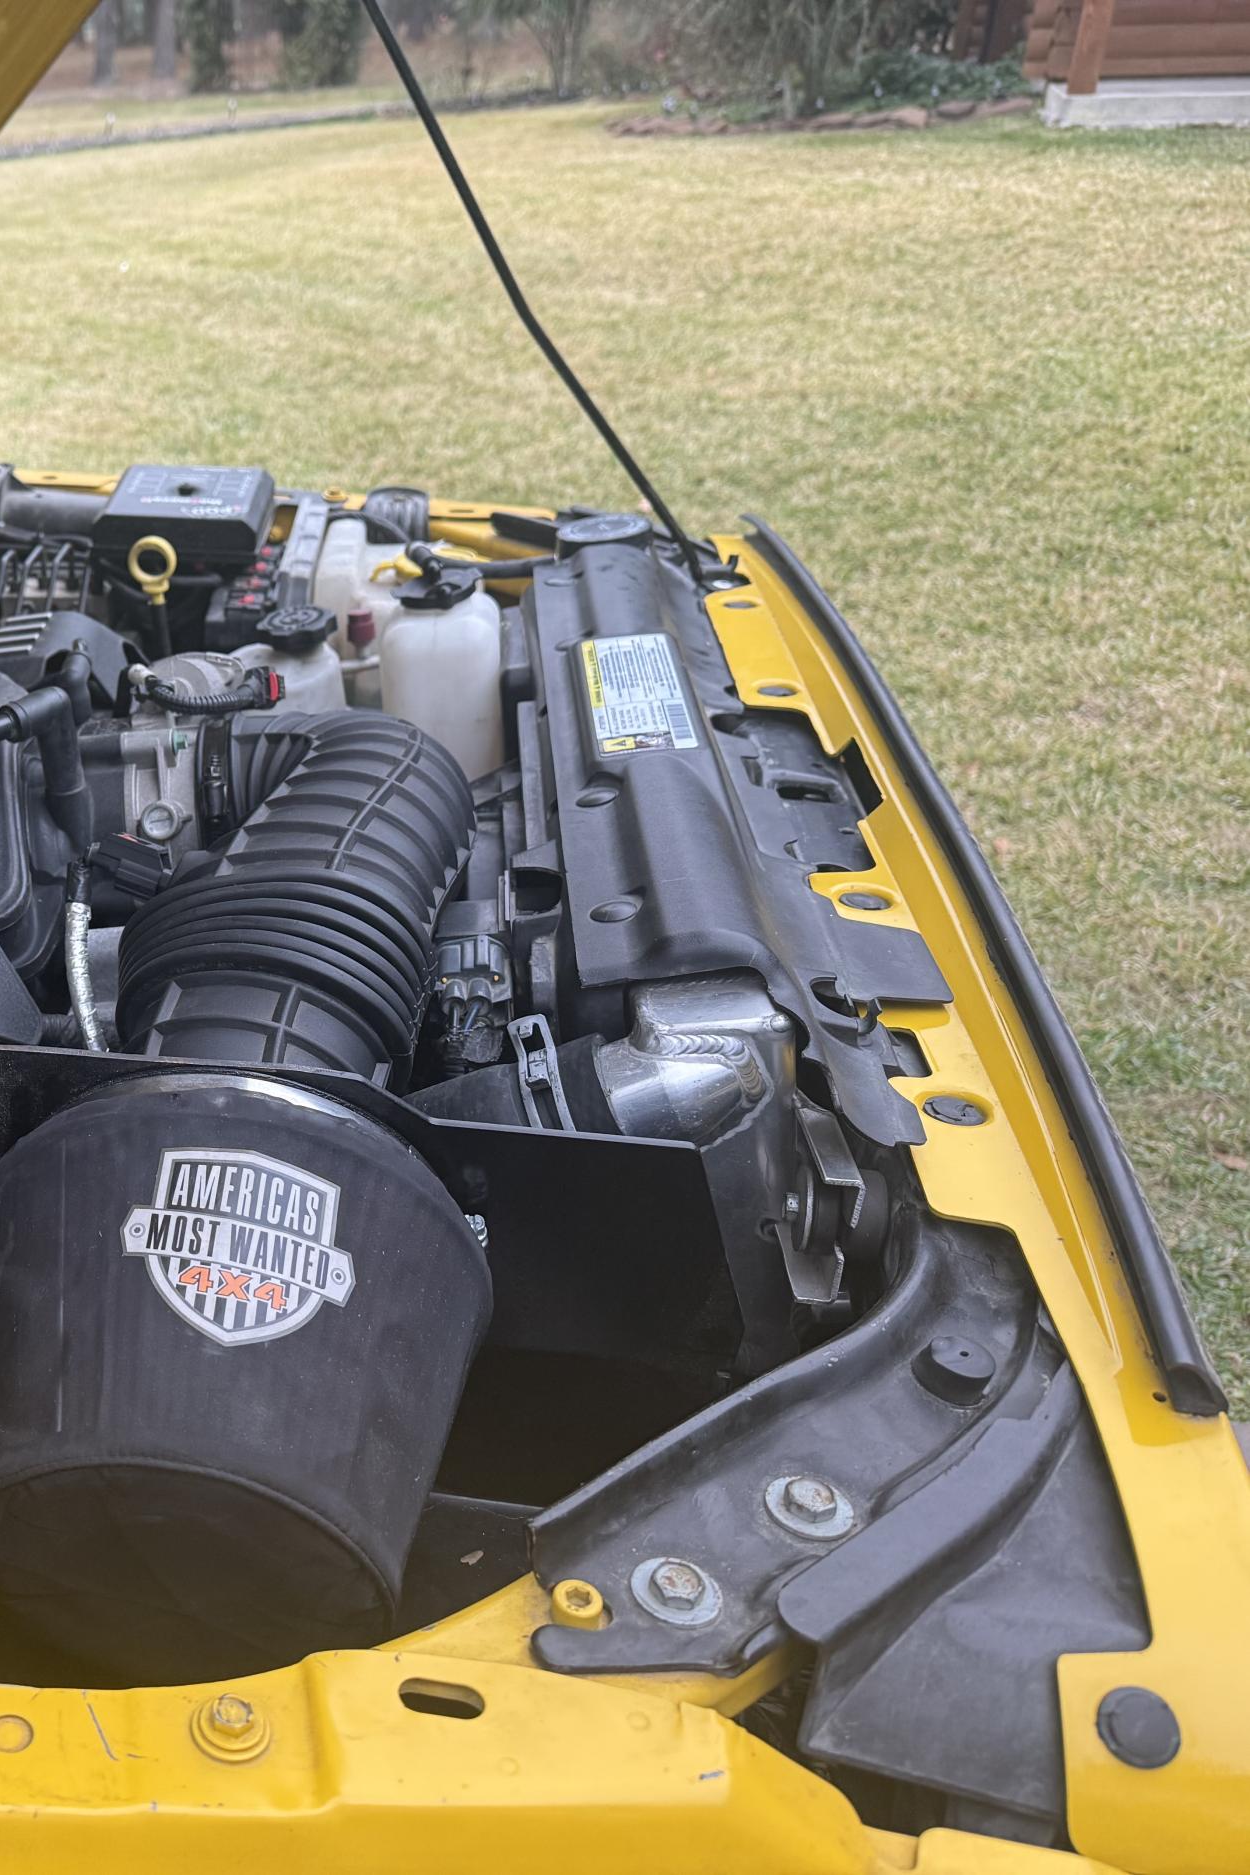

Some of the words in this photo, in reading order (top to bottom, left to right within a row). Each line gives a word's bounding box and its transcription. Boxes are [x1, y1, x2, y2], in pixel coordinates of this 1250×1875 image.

[171, 1163, 320, 1236] AMERICAS
[146, 1213, 222, 1258] MOST
[229, 1222, 331, 1291] WANTED
[178, 1264, 289, 1312] 4X4
